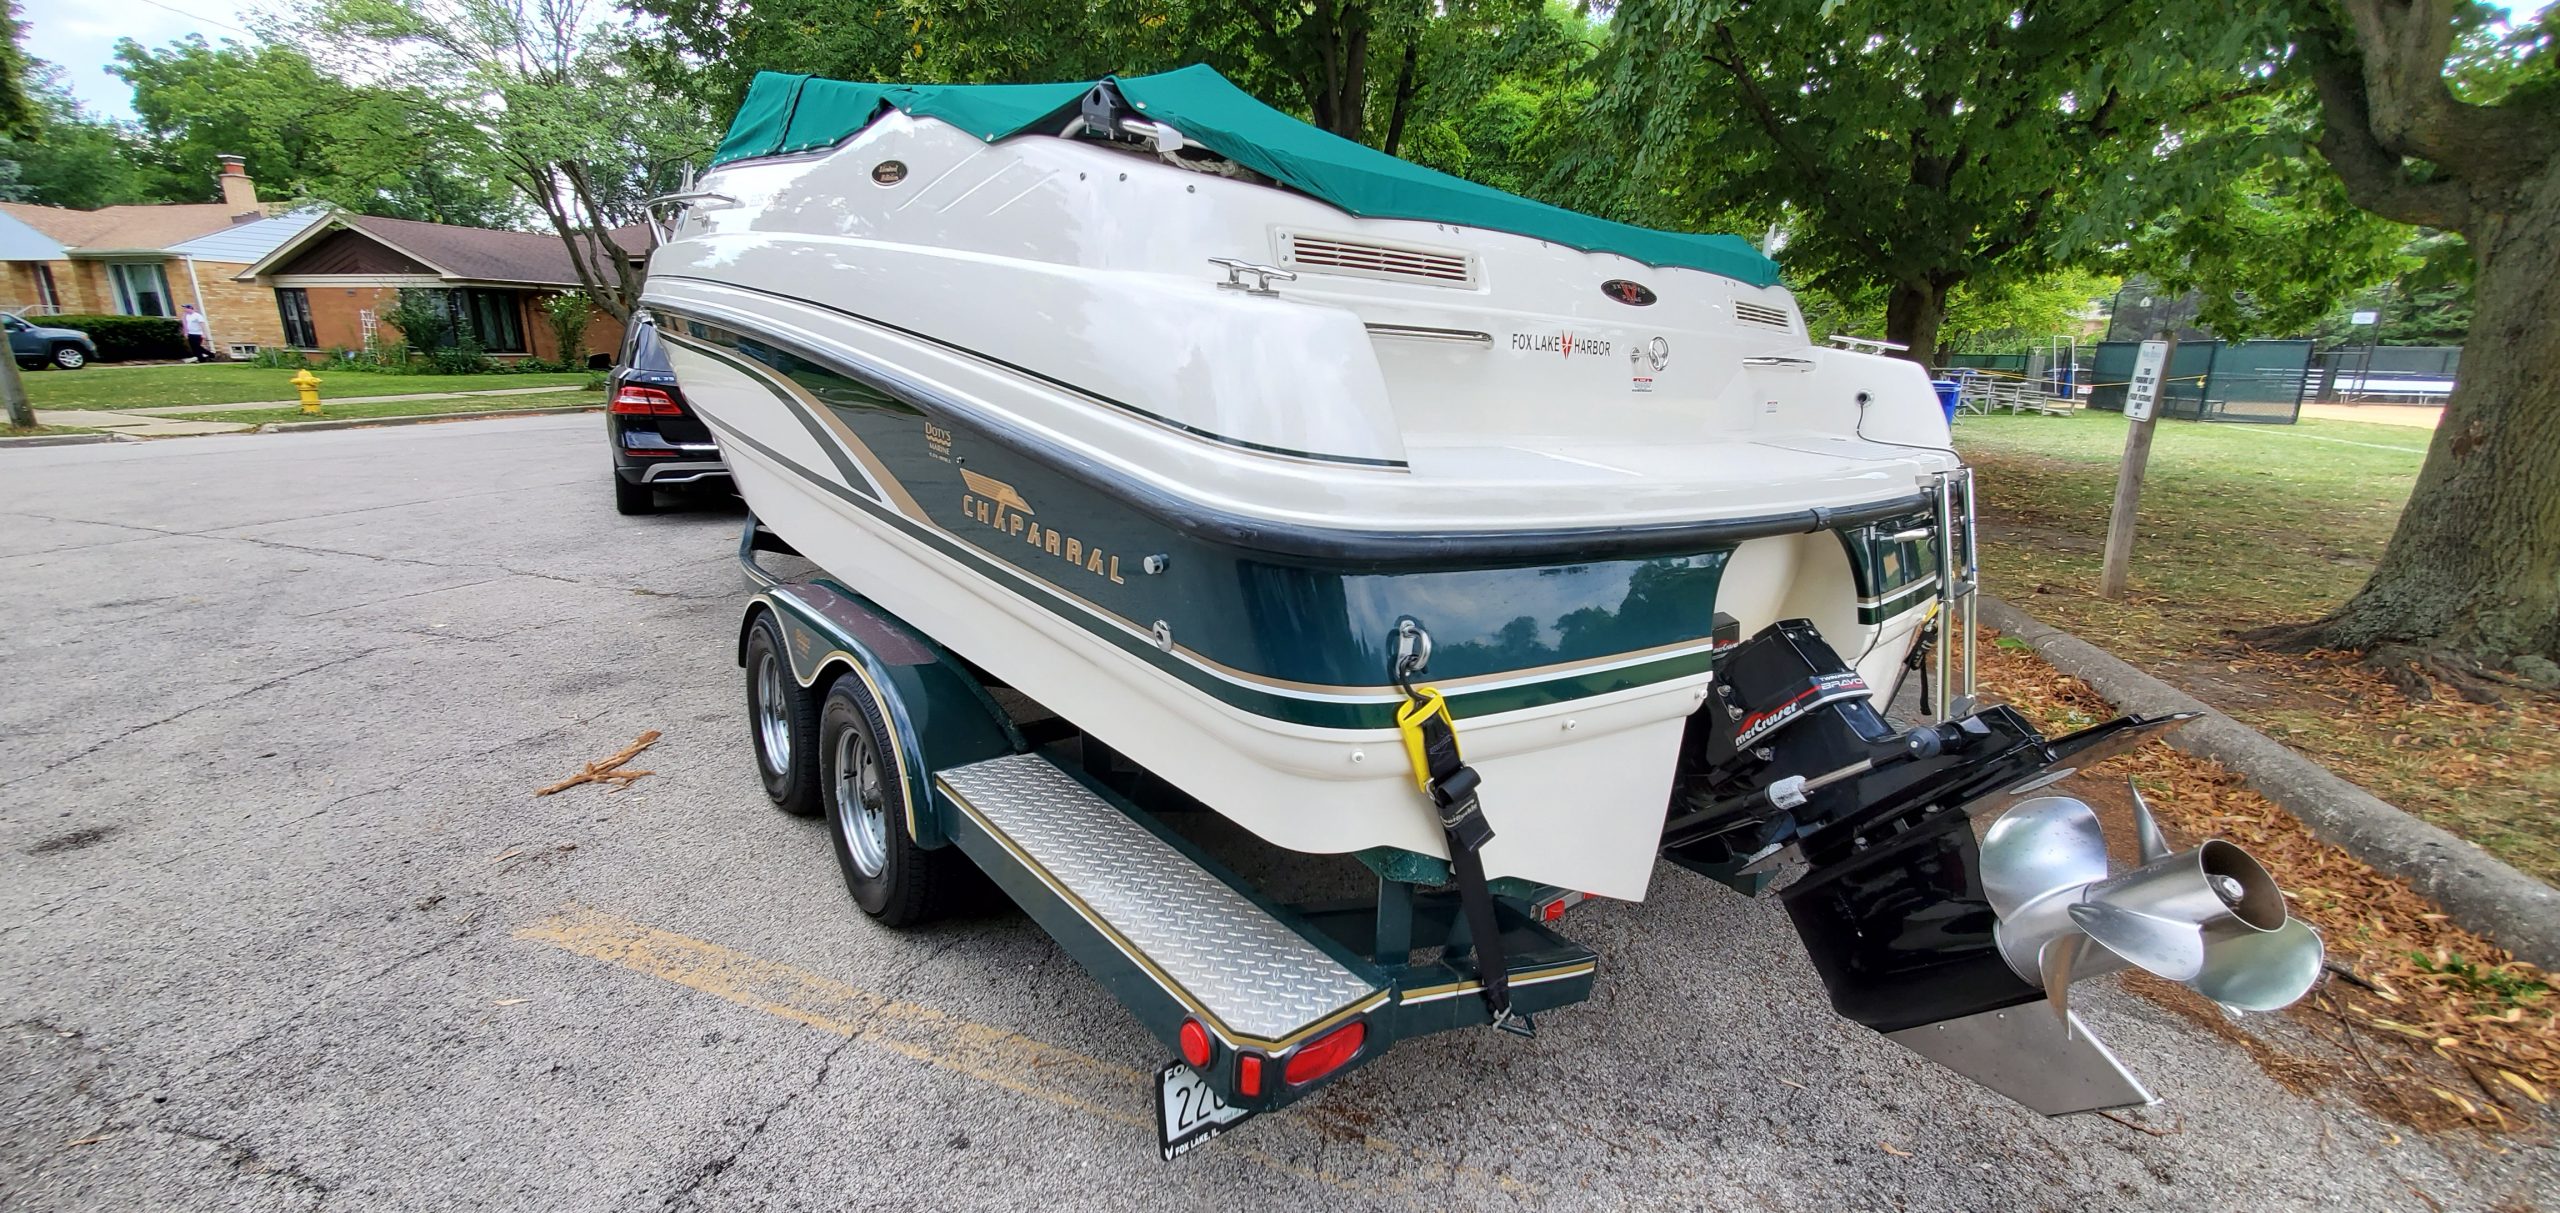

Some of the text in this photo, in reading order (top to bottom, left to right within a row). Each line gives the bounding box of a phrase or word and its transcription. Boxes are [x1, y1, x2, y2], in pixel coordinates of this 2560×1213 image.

[1512, 333, 1611, 357] FOX LAKE HARBOR
[963, 495, 1125, 585] CHAPARRAL
[1821, 678, 1863, 690] BRAVO
[1735, 702, 1797, 747] merCruiser
[1175, 1143, 1190, 1157] FOX
[1211, 1127, 1220, 1139] IL
